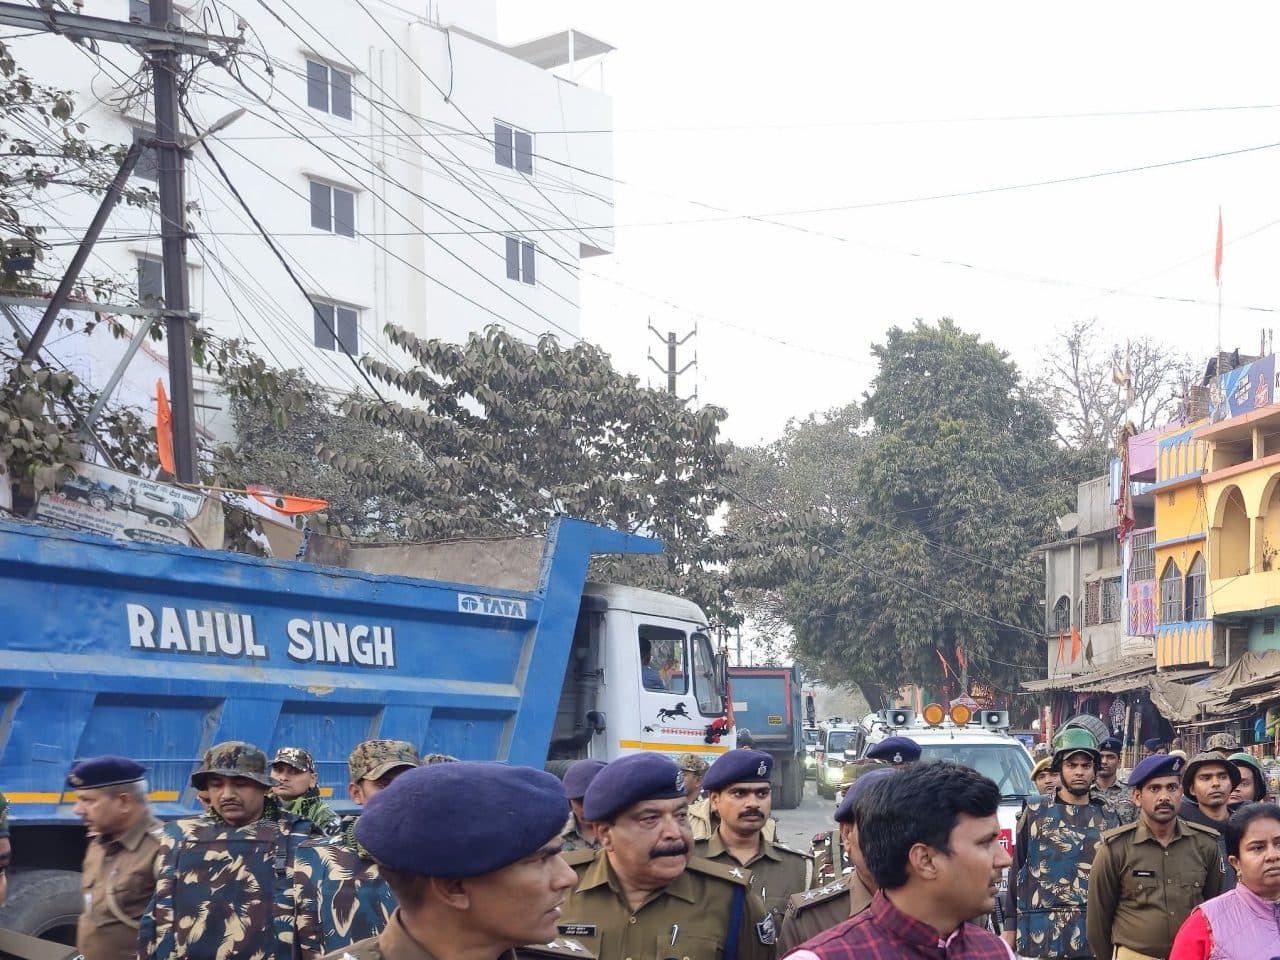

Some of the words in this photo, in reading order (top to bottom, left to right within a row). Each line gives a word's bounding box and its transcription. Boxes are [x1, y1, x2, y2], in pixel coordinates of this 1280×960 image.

[481, 597, 525, 617] TATA
[126, 603, 267, 657] RAHUL
[287, 617, 397, 667] SINGH
